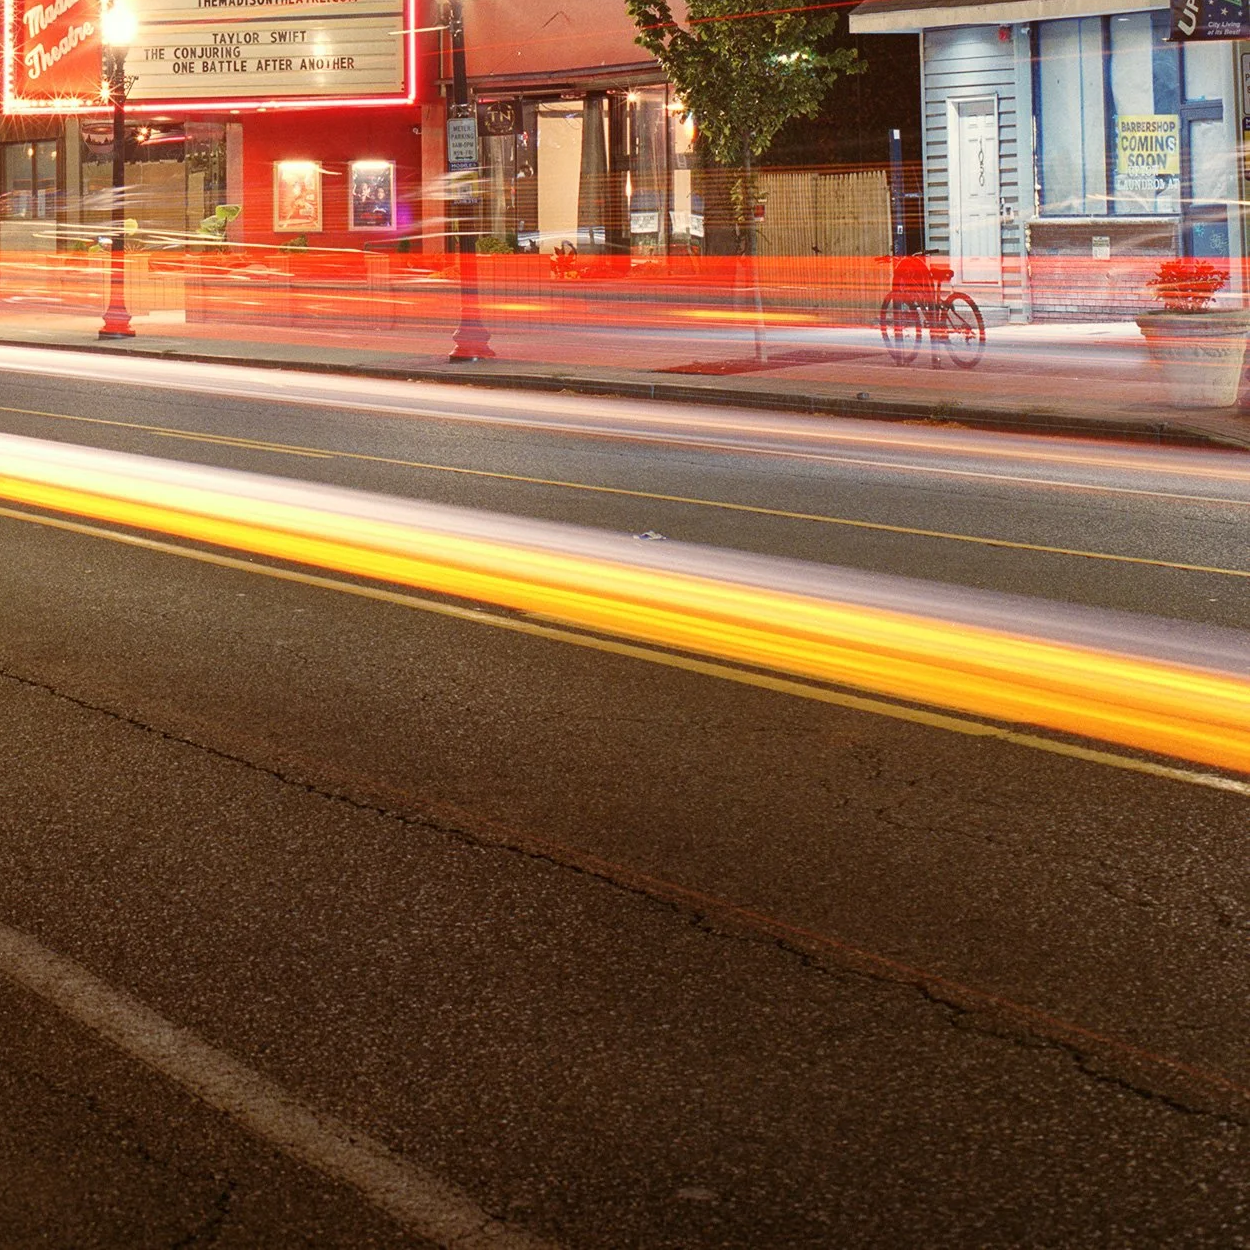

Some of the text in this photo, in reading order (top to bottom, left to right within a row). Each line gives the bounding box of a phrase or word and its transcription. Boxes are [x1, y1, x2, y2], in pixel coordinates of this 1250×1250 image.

[1207, 21, 1241, 29] City Living
[212, 30, 307, 44] TAYLOR SWIFT
[24, 21, 95, 79] Theatre
[143, 46, 241, 60] THE CONJURING
[172, 57, 355, 73] ONE BATTLE AFTER ANOTHER
[486, 110, 511, 123] TN
[1121, 121, 1176, 133] BARBERSHOP
[1128, 153, 1167, 169] SOON
